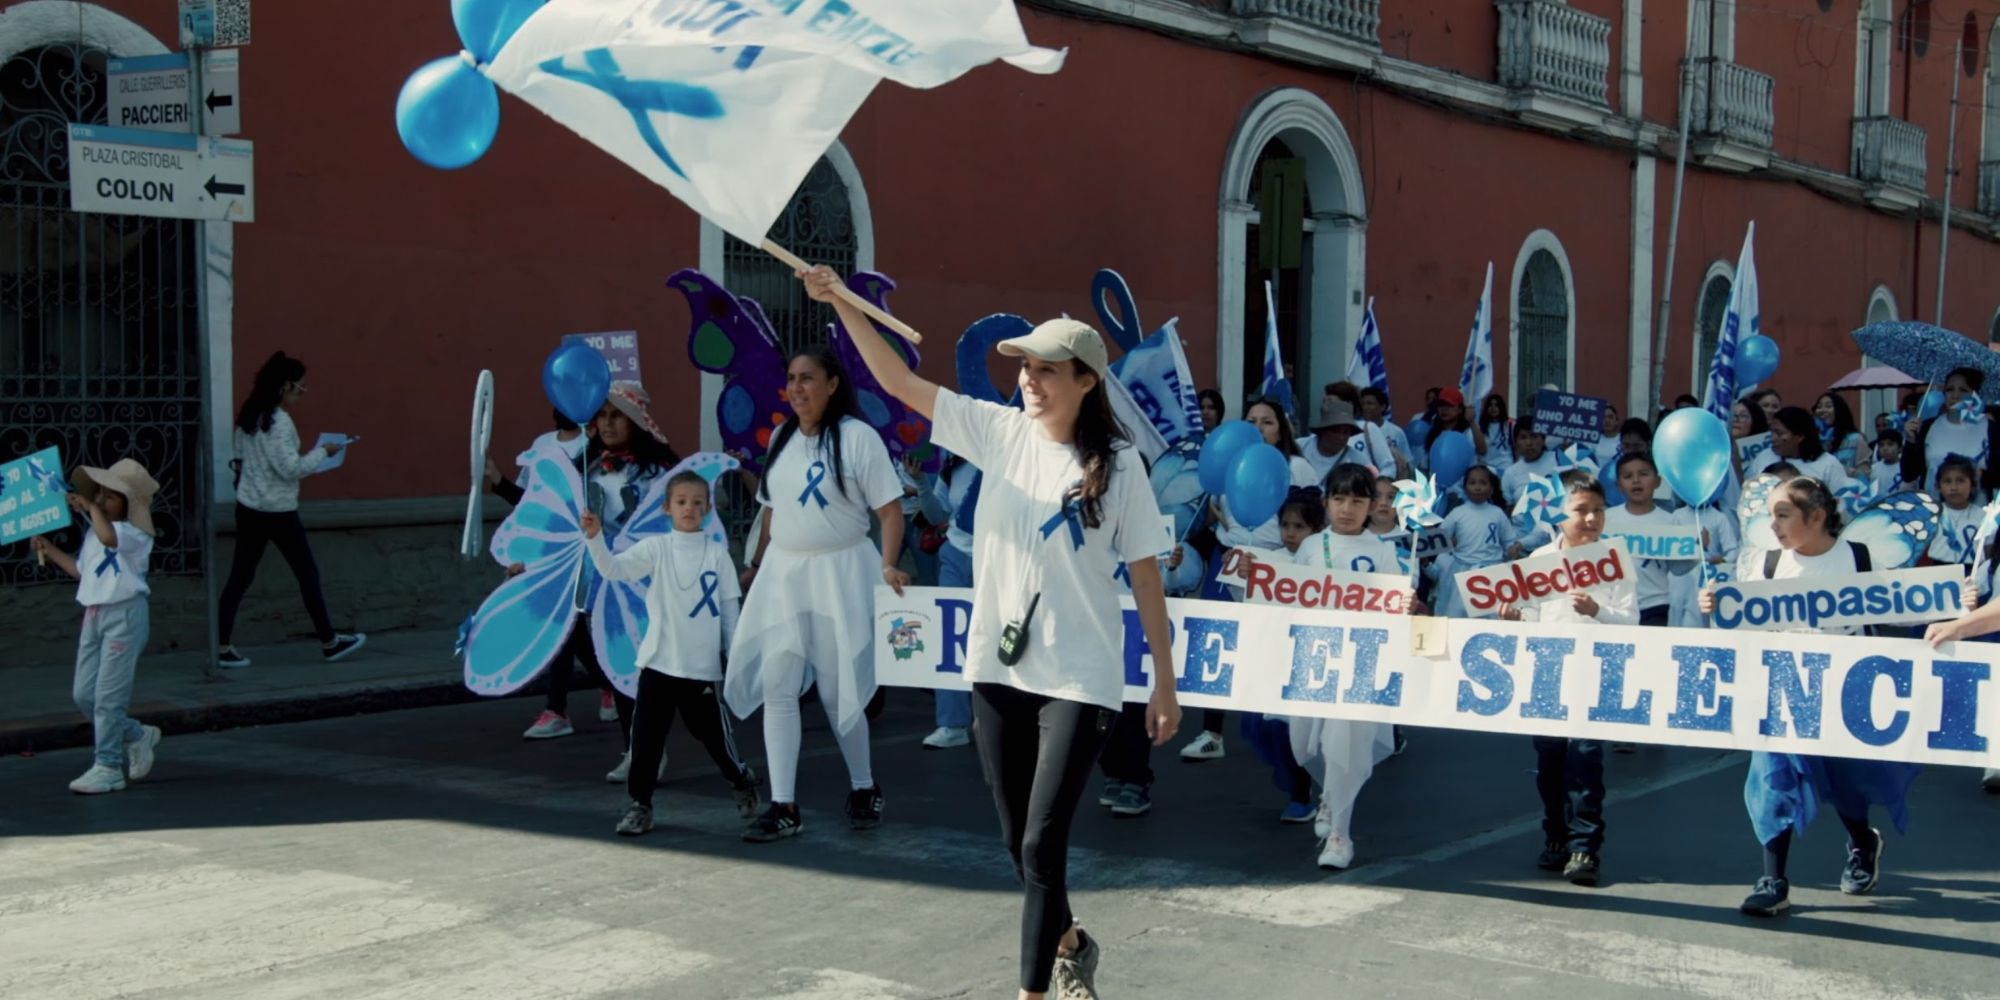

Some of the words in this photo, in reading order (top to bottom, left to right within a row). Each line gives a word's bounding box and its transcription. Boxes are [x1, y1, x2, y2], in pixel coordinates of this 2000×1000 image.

[120, 78, 139, 93] CALLE
[141, 74, 186, 92] GUERRILLEROS
[121, 103, 188, 126] PACCIERI
[82, 146, 119, 165] PLAZA
[121, 150, 183, 170] CRISTOBAL
[96, 178, 174, 203] COLON
[584, 336, 605, 350] YO
[610, 335, 634, 349] ME
[628, 357, 638, 371] 9
[1559, 395, 1575, 407] YO
[1577, 398, 1599, 411] ME
[1536, 409, 1564, 423] UNO
[1568, 413, 1585, 425] AL
[1589, 415, 1598, 426] 9
[1533, 423, 1549, 434] DE
[1552, 425, 1600, 441] AGOSTO
[21, 488, 35, 506] AL
[2, 520, 17, 537] DE
[20, 505, 60, 532] AGOSTO
[1245, 561, 1405, 615] Rechazo
[1466, 548, 1624, 609] Soledad
[1713, 580, 1961, 629] Compasion
[1414, 633, 1426, 651] 1
[935, 598, 1240, 698] RPE
[1281, 623, 1403, 707] EL
[1456, 632, 1991, 752] SILENCI
